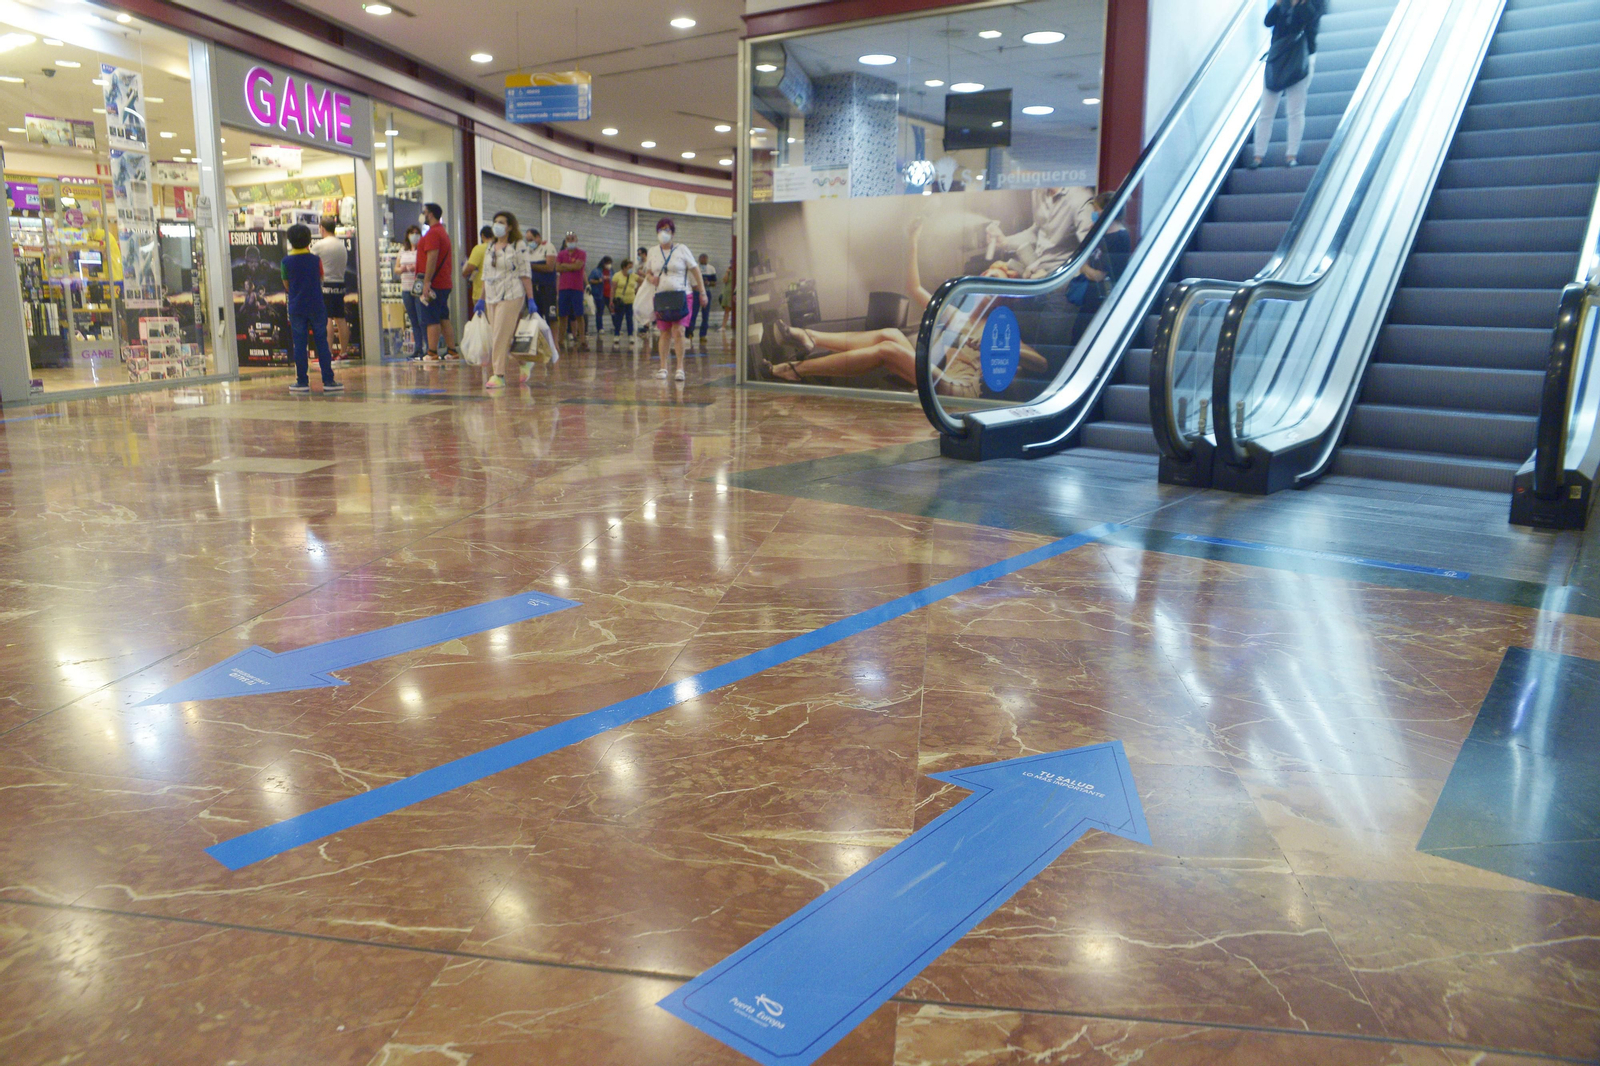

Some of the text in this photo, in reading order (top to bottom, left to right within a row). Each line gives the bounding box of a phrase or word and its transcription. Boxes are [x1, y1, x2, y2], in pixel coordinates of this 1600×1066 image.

[244, 65, 354, 148] GAME
[997, 165, 1087, 189] peluqueros
[258, 231, 273, 245] EVIL
[273, 231, 278, 245] 3
[81, 349, 115, 359] GAME
[1040, 770, 1095, 790] TU SALUD
[1053, 780, 1106, 799] IMPORTANTE
[729, 996, 756, 1014] Puerta
[756, 1010, 786, 1030] Europa
